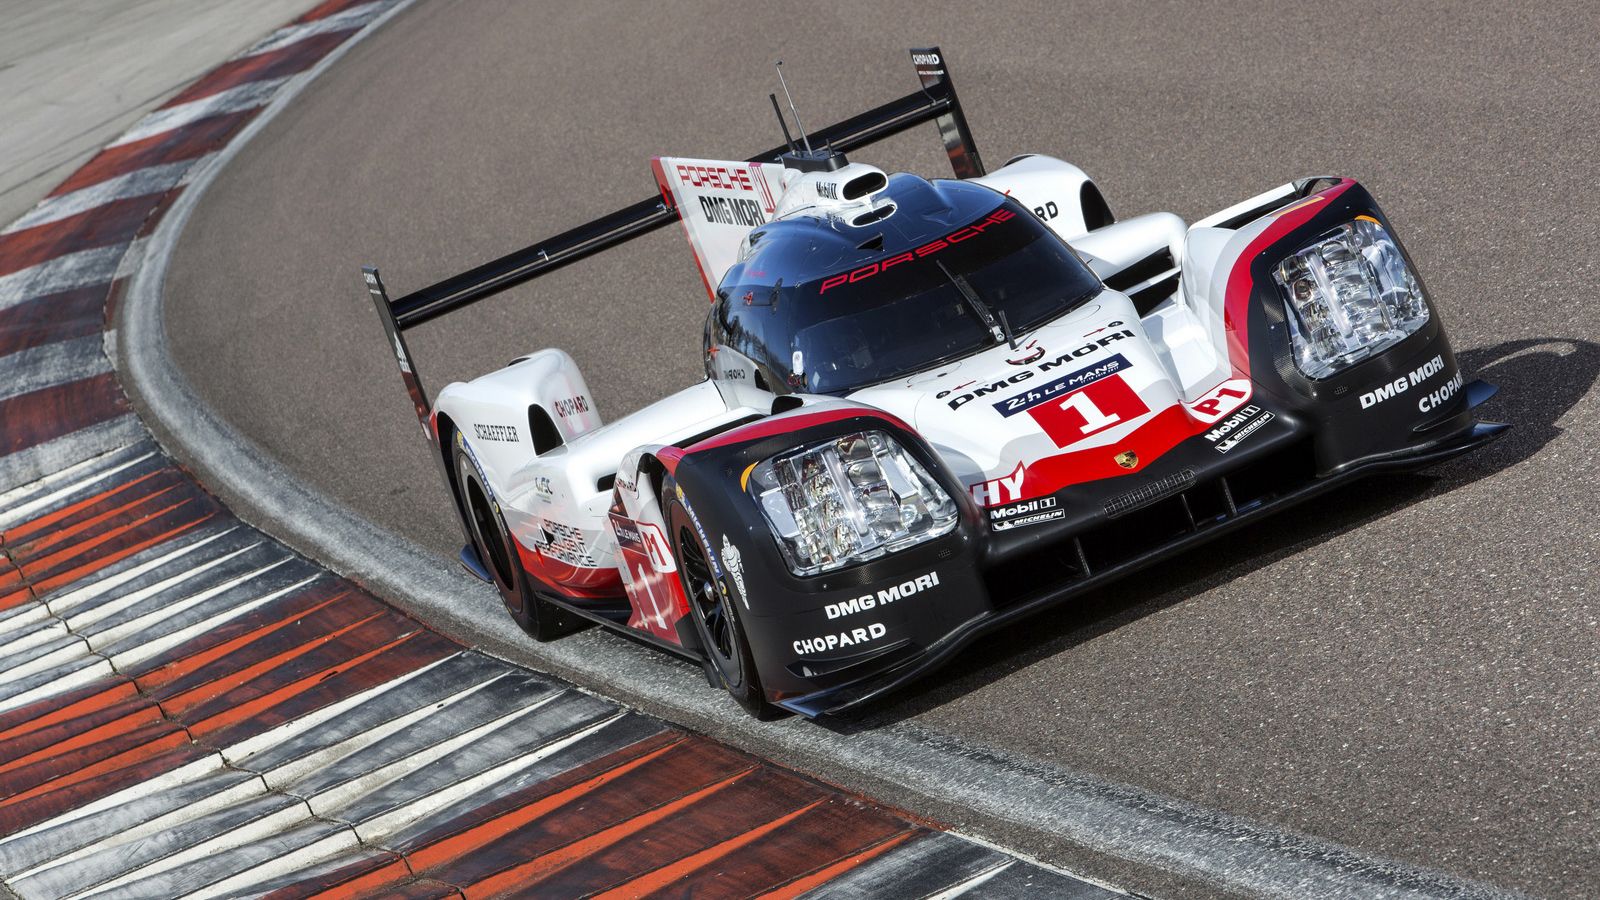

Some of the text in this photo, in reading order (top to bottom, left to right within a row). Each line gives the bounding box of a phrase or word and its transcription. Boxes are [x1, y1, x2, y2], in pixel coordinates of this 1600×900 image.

[676, 164, 753, 191] PORSCHE
[698, 195, 766, 228] DMG MORI
[819, 208, 1017, 295] PORSCHE
[948, 329, 1135, 411] DMG MORI
[1044, 382, 1066, 395] LE
[1069, 360, 1120, 386] MANS
[1359, 354, 1445, 409] DMG MORI
[554, 395, 589, 418] CHOPARD
[1059, 391, 1121, 435] 1
[1191, 387, 1246, 417] P1
[474, 423, 519, 442] SCHAEFFLER
[1204, 411, 1248, 442] Mobil
[1233, 413, 1271, 441] MICHELIN
[990, 501, 1039, 520] Mobil
[1013, 510, 1063, 526] MICHELIN
[824, 571, 940, 619] DMG MORI
[792, 622, 887, 655] CHOPARD
